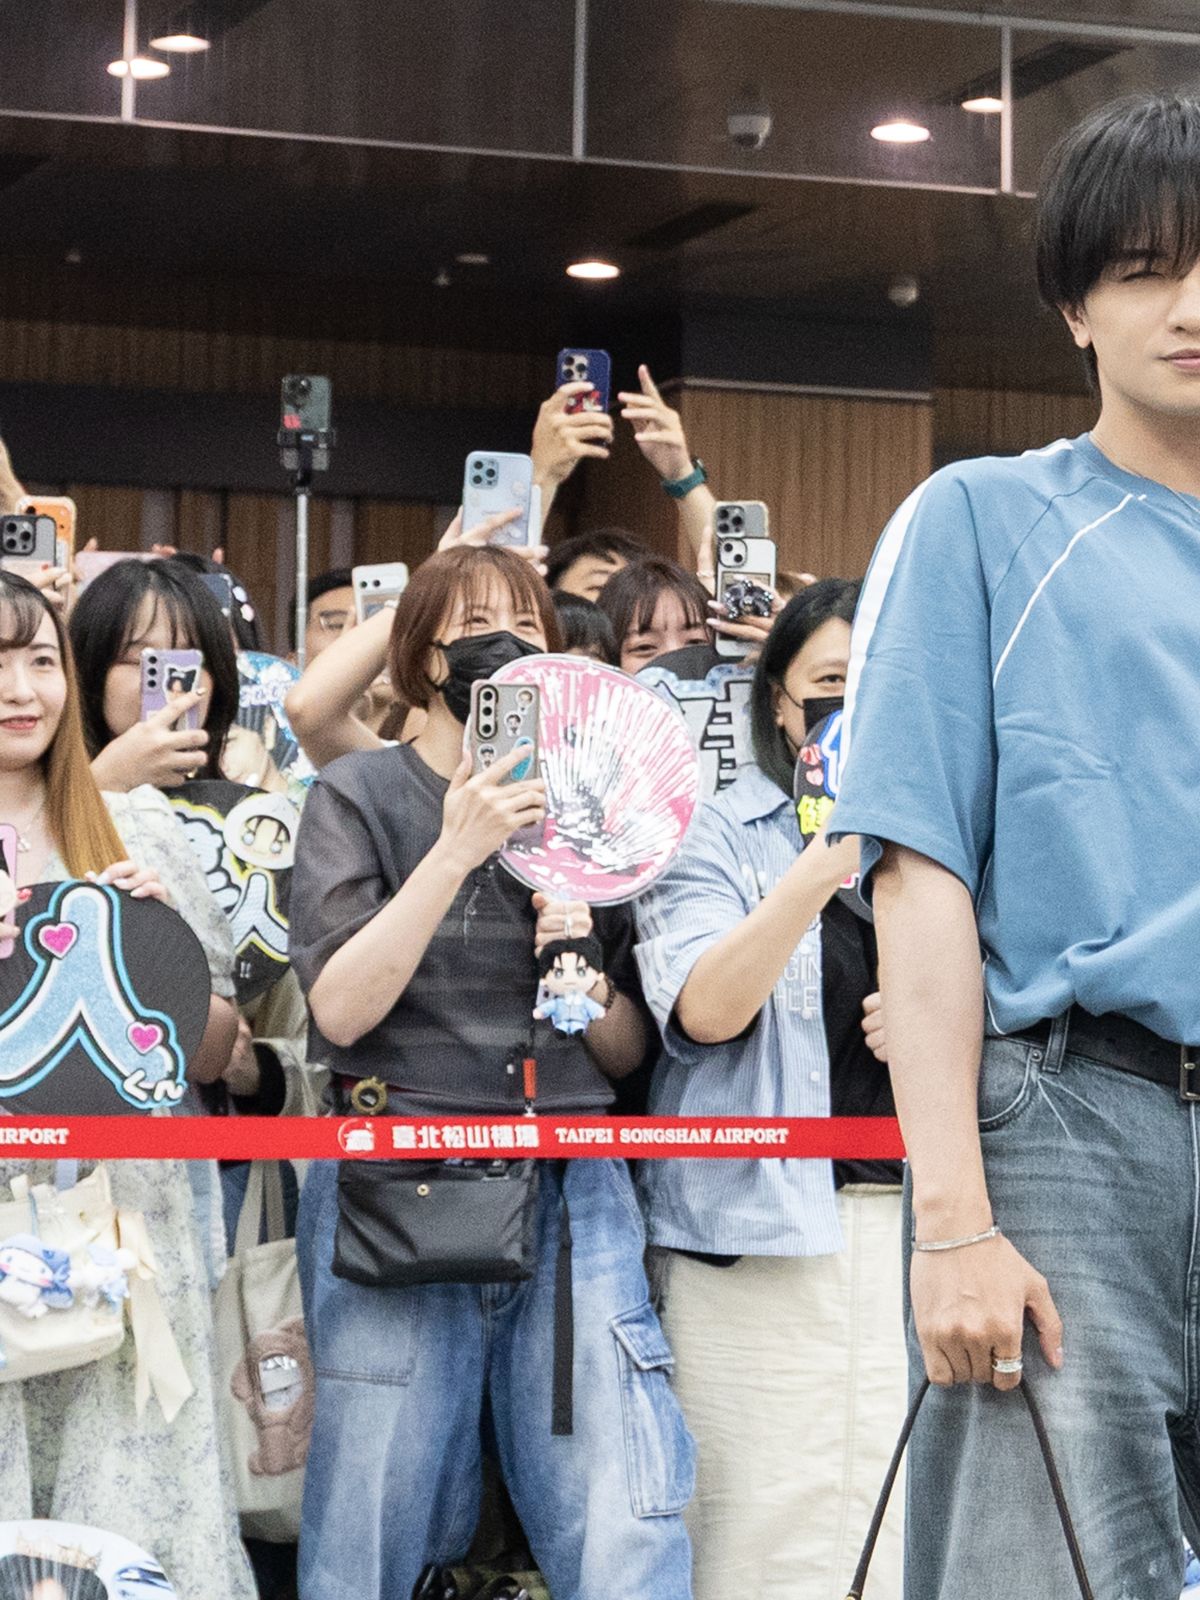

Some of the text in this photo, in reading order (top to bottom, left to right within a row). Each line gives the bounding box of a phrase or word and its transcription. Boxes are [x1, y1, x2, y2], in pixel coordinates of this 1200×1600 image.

[0, 1127, 69, 1144] IRPORT
[554, 1127, 614, 1144] TAIPEI
[619, 1127, 711, 1144] SONGSHAN
[713, 1127, 789, 1144] AIRPORT
